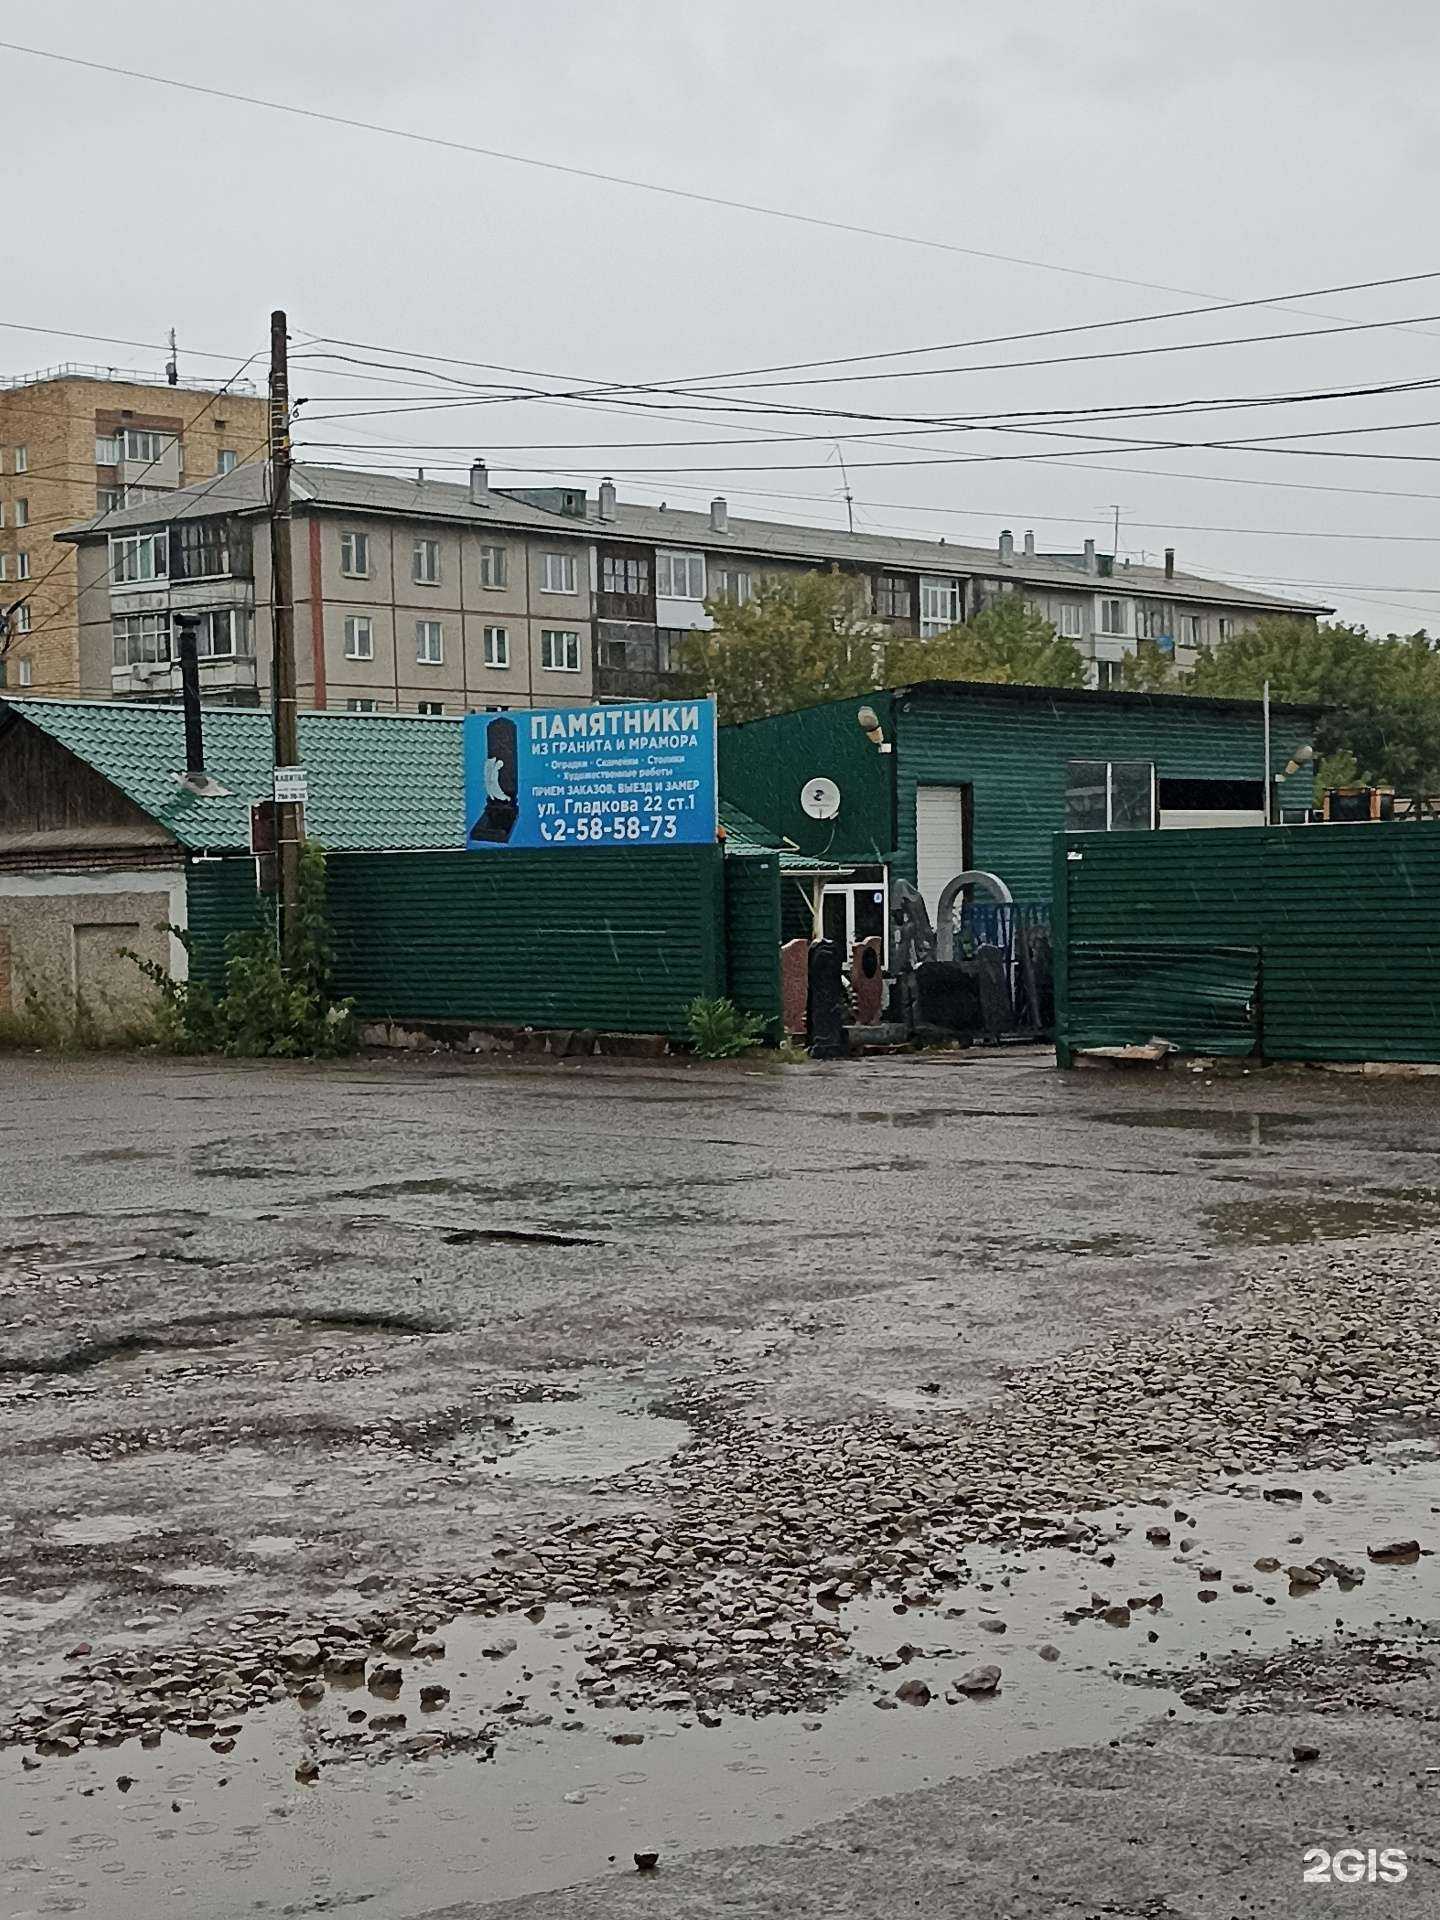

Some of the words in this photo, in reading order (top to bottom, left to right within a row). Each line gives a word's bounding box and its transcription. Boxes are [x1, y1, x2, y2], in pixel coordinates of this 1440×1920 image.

[531, 706, 700, 740] ПАМЯТНИКИ
[532, 742, 549, 755] ИЗ
[552, 739, 612, 754] ГРАНИТА
[616, 738, 625, 750] И
[629, 734, 698, 750] МРАМОРА
[639, 767, 673, 779] работы
[618, 782, 653, 795] ВЫЕЗД
[655, 781, 663, 792] И
[665, 780, 700, 792] ЗАМЕР
[538, 802, 560, 818] ул.
[564, 799, 639, 816] Гладкова
[643, 796, 663, 812] 22
[667, 794, 696, 811] ст.1
[553, 815, 677, 841] 2-58-58-73
